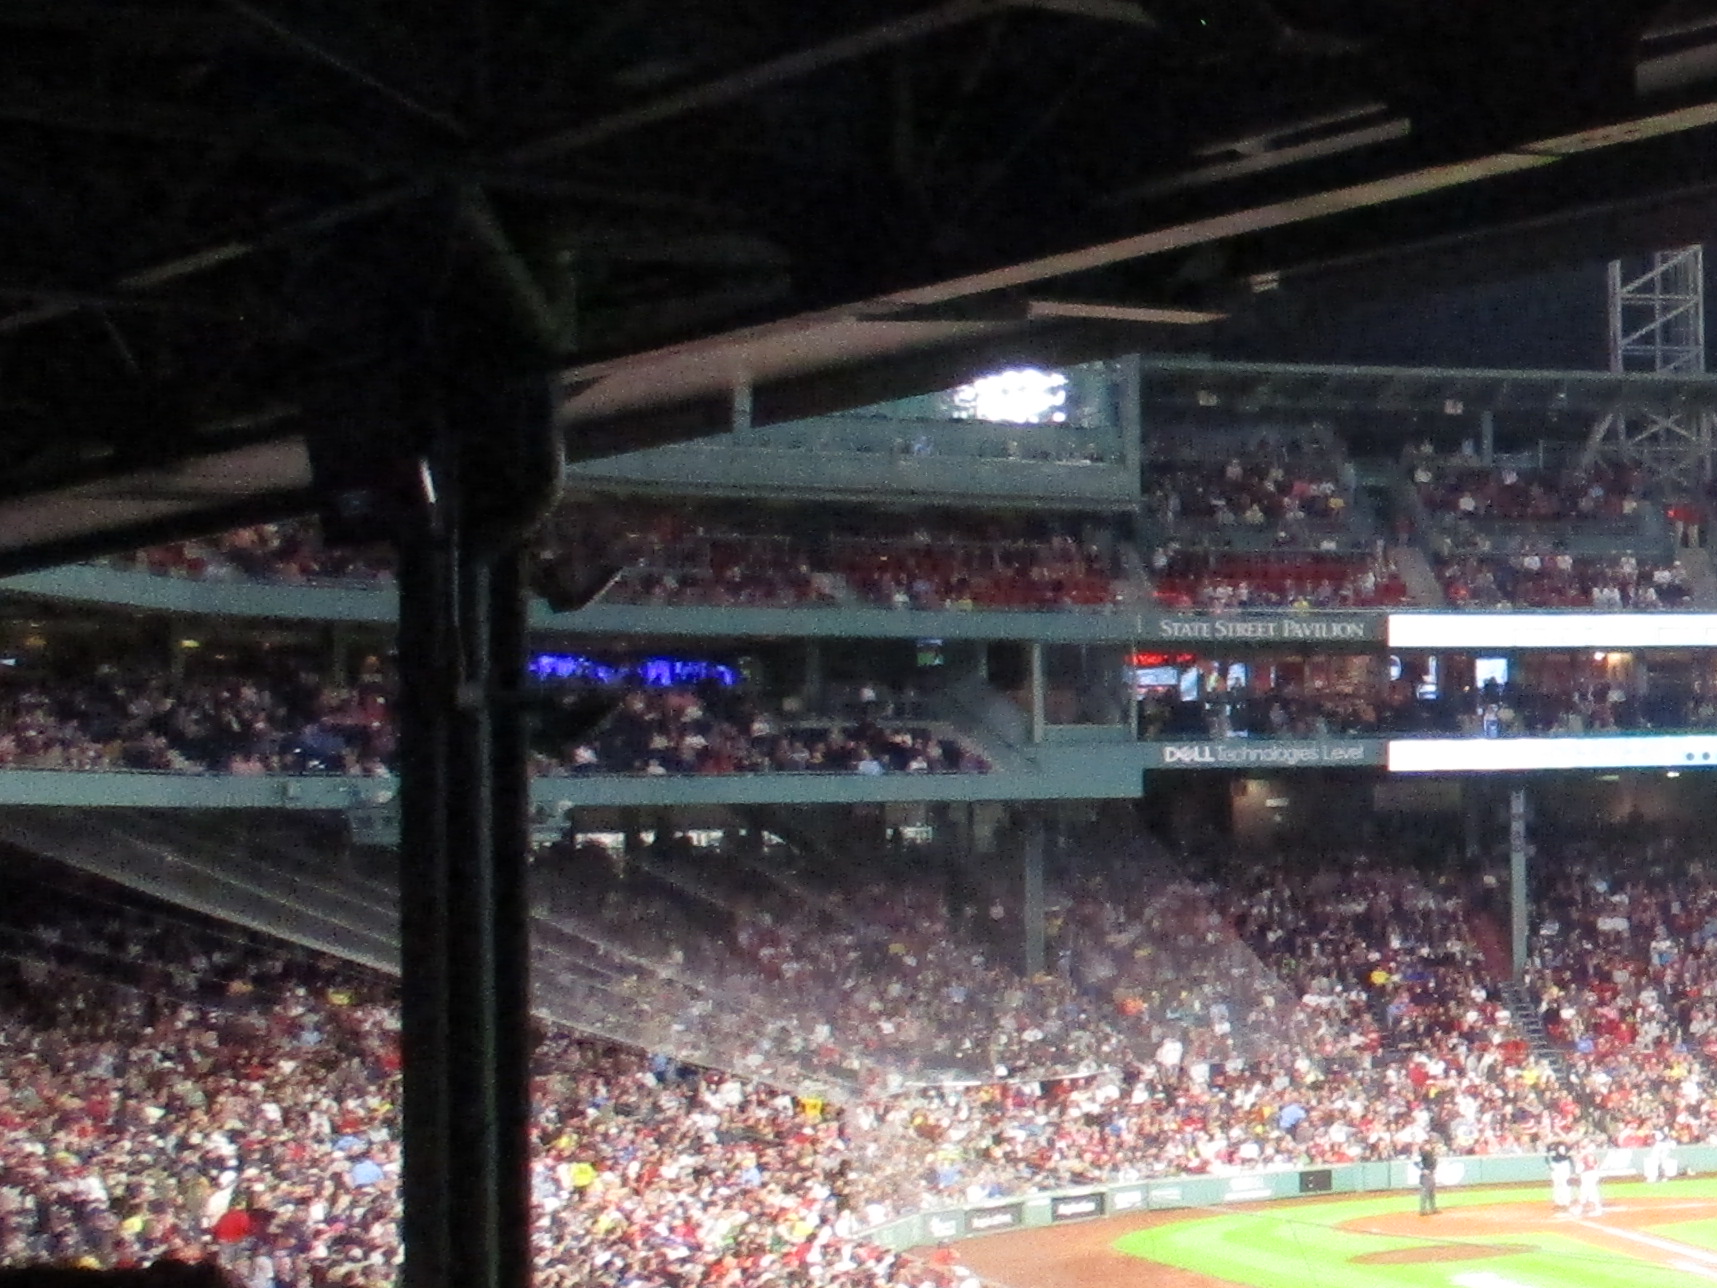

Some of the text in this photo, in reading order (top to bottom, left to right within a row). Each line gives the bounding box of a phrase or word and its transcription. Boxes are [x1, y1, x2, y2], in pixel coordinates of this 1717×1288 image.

[1160, 620, 1364, 637] STATE STREET PAVILION
[1163, 745, 1364, 765] DELL Technologies Level
